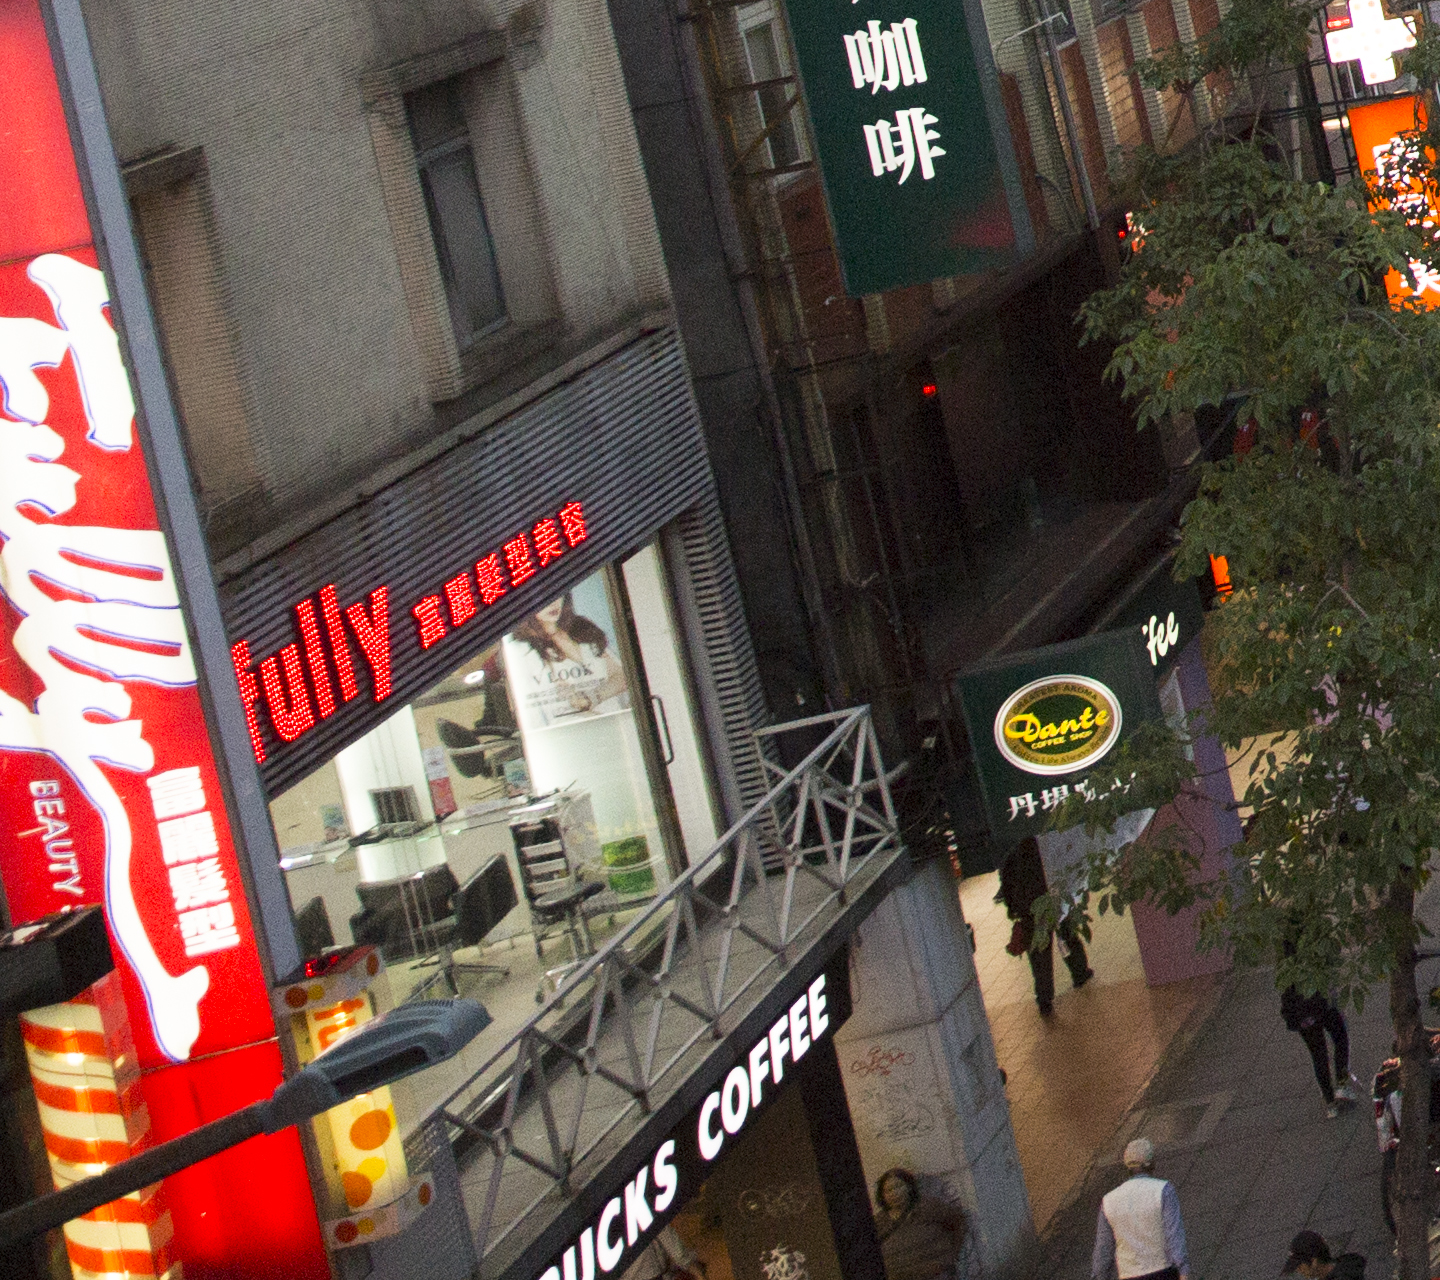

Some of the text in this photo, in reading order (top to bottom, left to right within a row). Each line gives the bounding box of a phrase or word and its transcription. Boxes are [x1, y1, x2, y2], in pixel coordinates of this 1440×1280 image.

[1004, 707, 1110, 743] Dante
[1031, 736, 1066, 750] COFFEE
[29, 779, 84, 896] BEAUTY
[698, 974, 829, 1160] COFFEE
